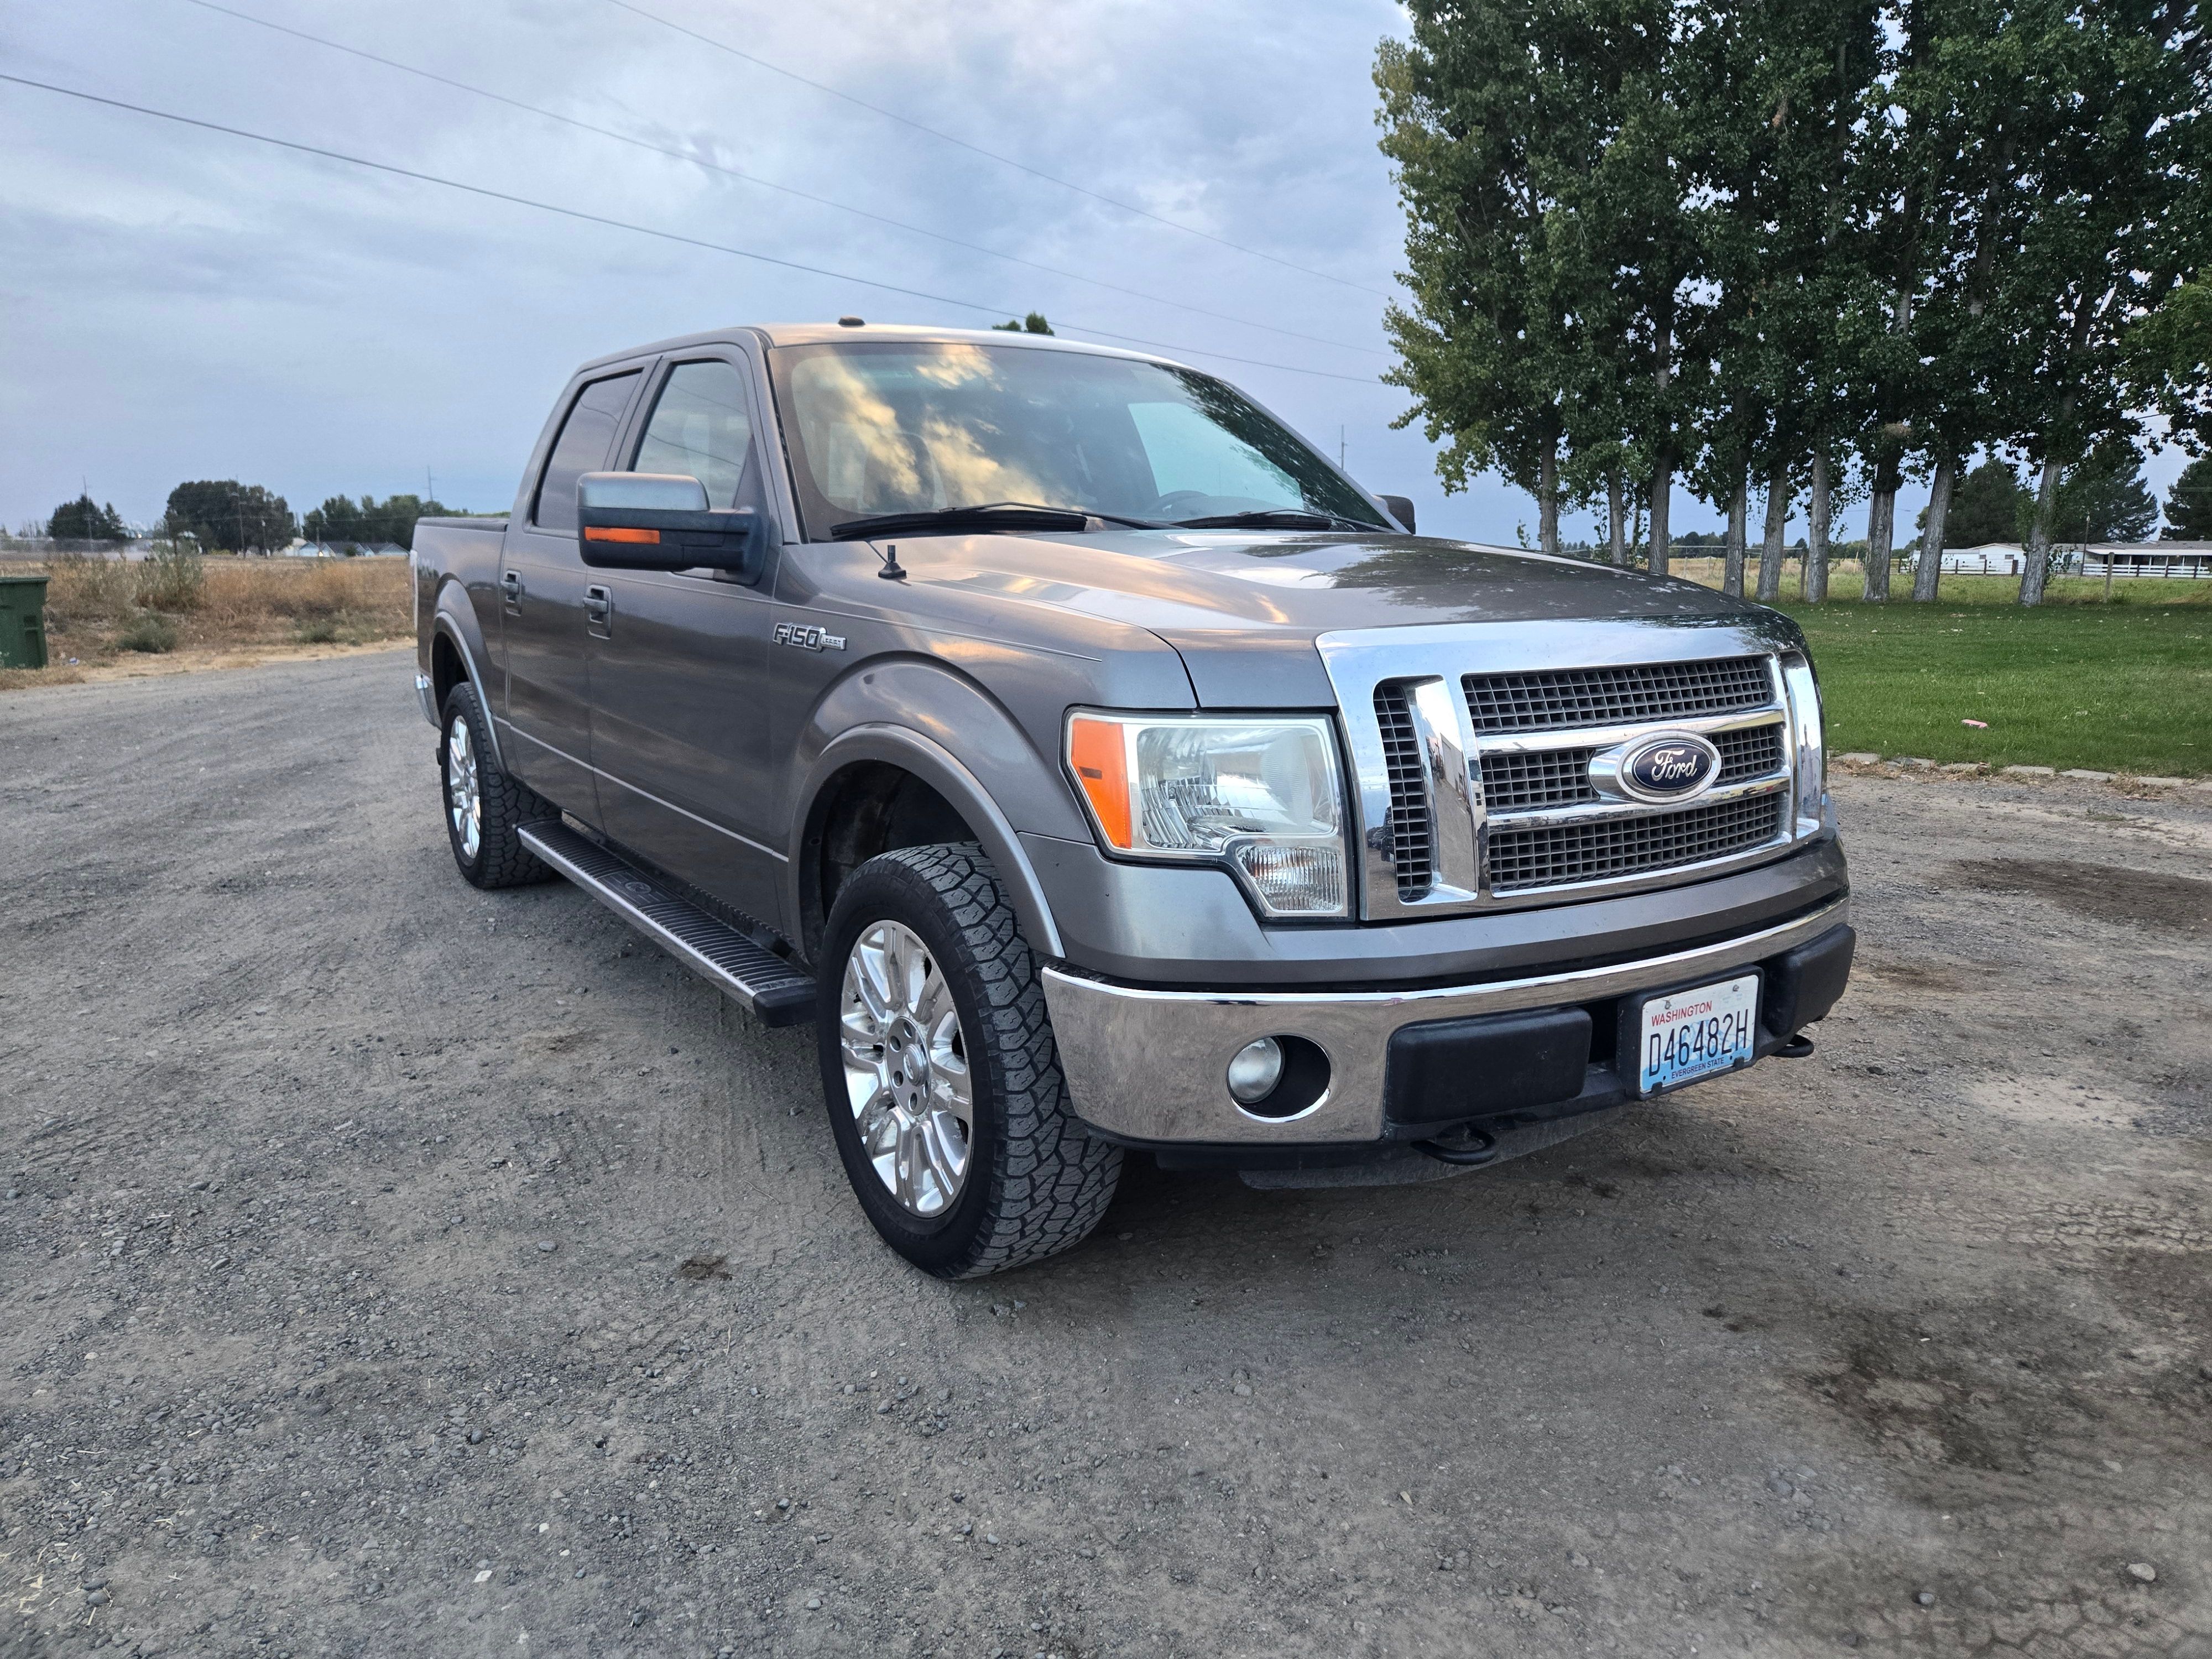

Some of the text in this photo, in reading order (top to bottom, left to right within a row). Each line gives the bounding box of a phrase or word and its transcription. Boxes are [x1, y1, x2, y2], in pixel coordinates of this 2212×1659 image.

[773, 623, 821, 651] F-150
[1651, 749, 1698, 781] Ford
[1651, 1000, 1713, 1026] WASHINGTON
[1648, 1009, 1749, 1077] D46482H
[1671, 1057, 1724, 1078] EVERGREEN STATE
